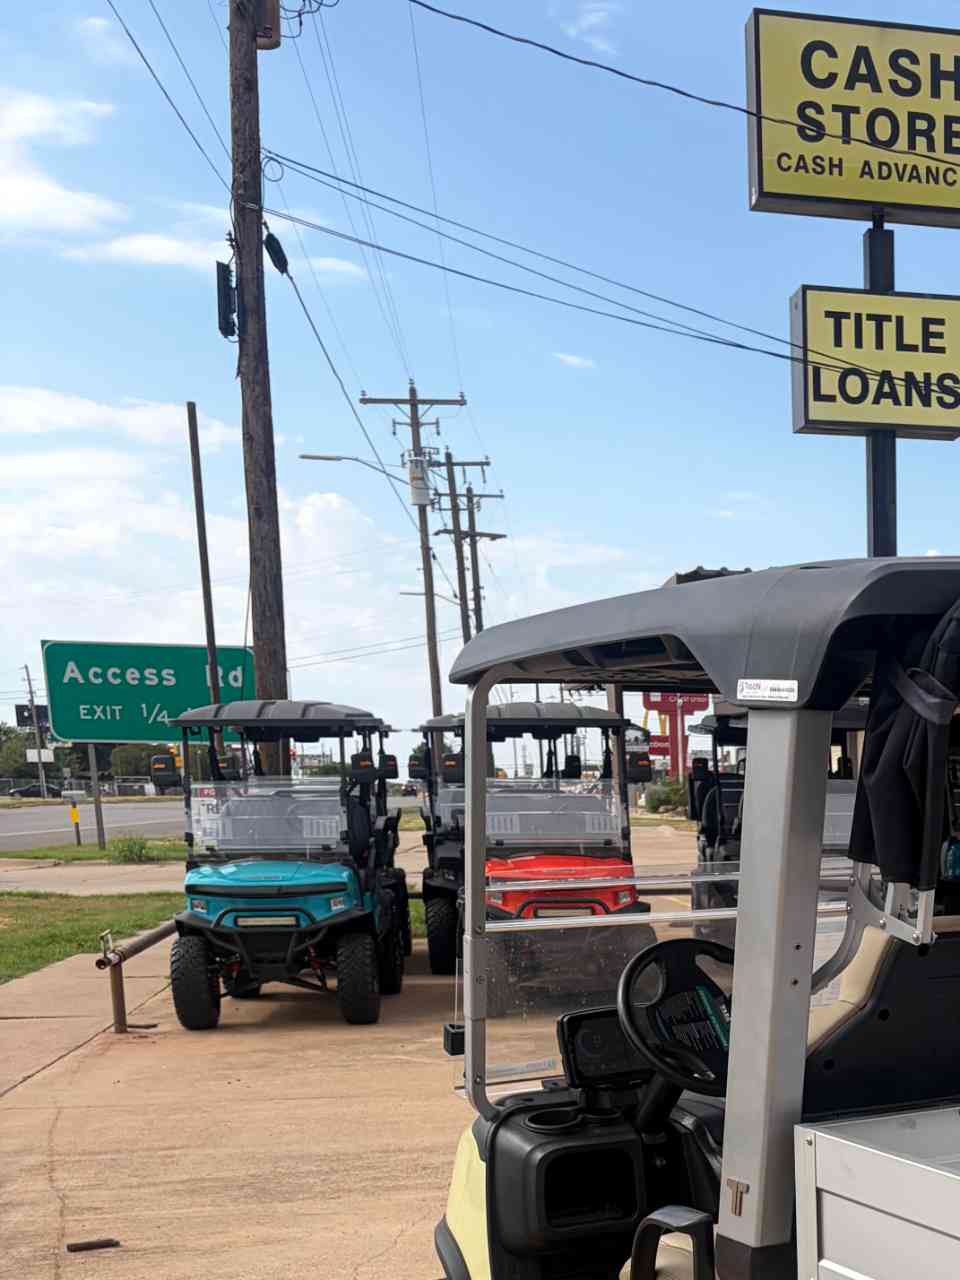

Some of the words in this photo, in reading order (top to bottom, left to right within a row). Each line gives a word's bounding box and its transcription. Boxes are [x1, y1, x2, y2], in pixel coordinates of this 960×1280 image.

[776, 152, 844, 178] CASH
[824, 310, 947, 354] TITLE
[62, 661, 177, 687] Access
[79, 705, 123, 721] EXIT
